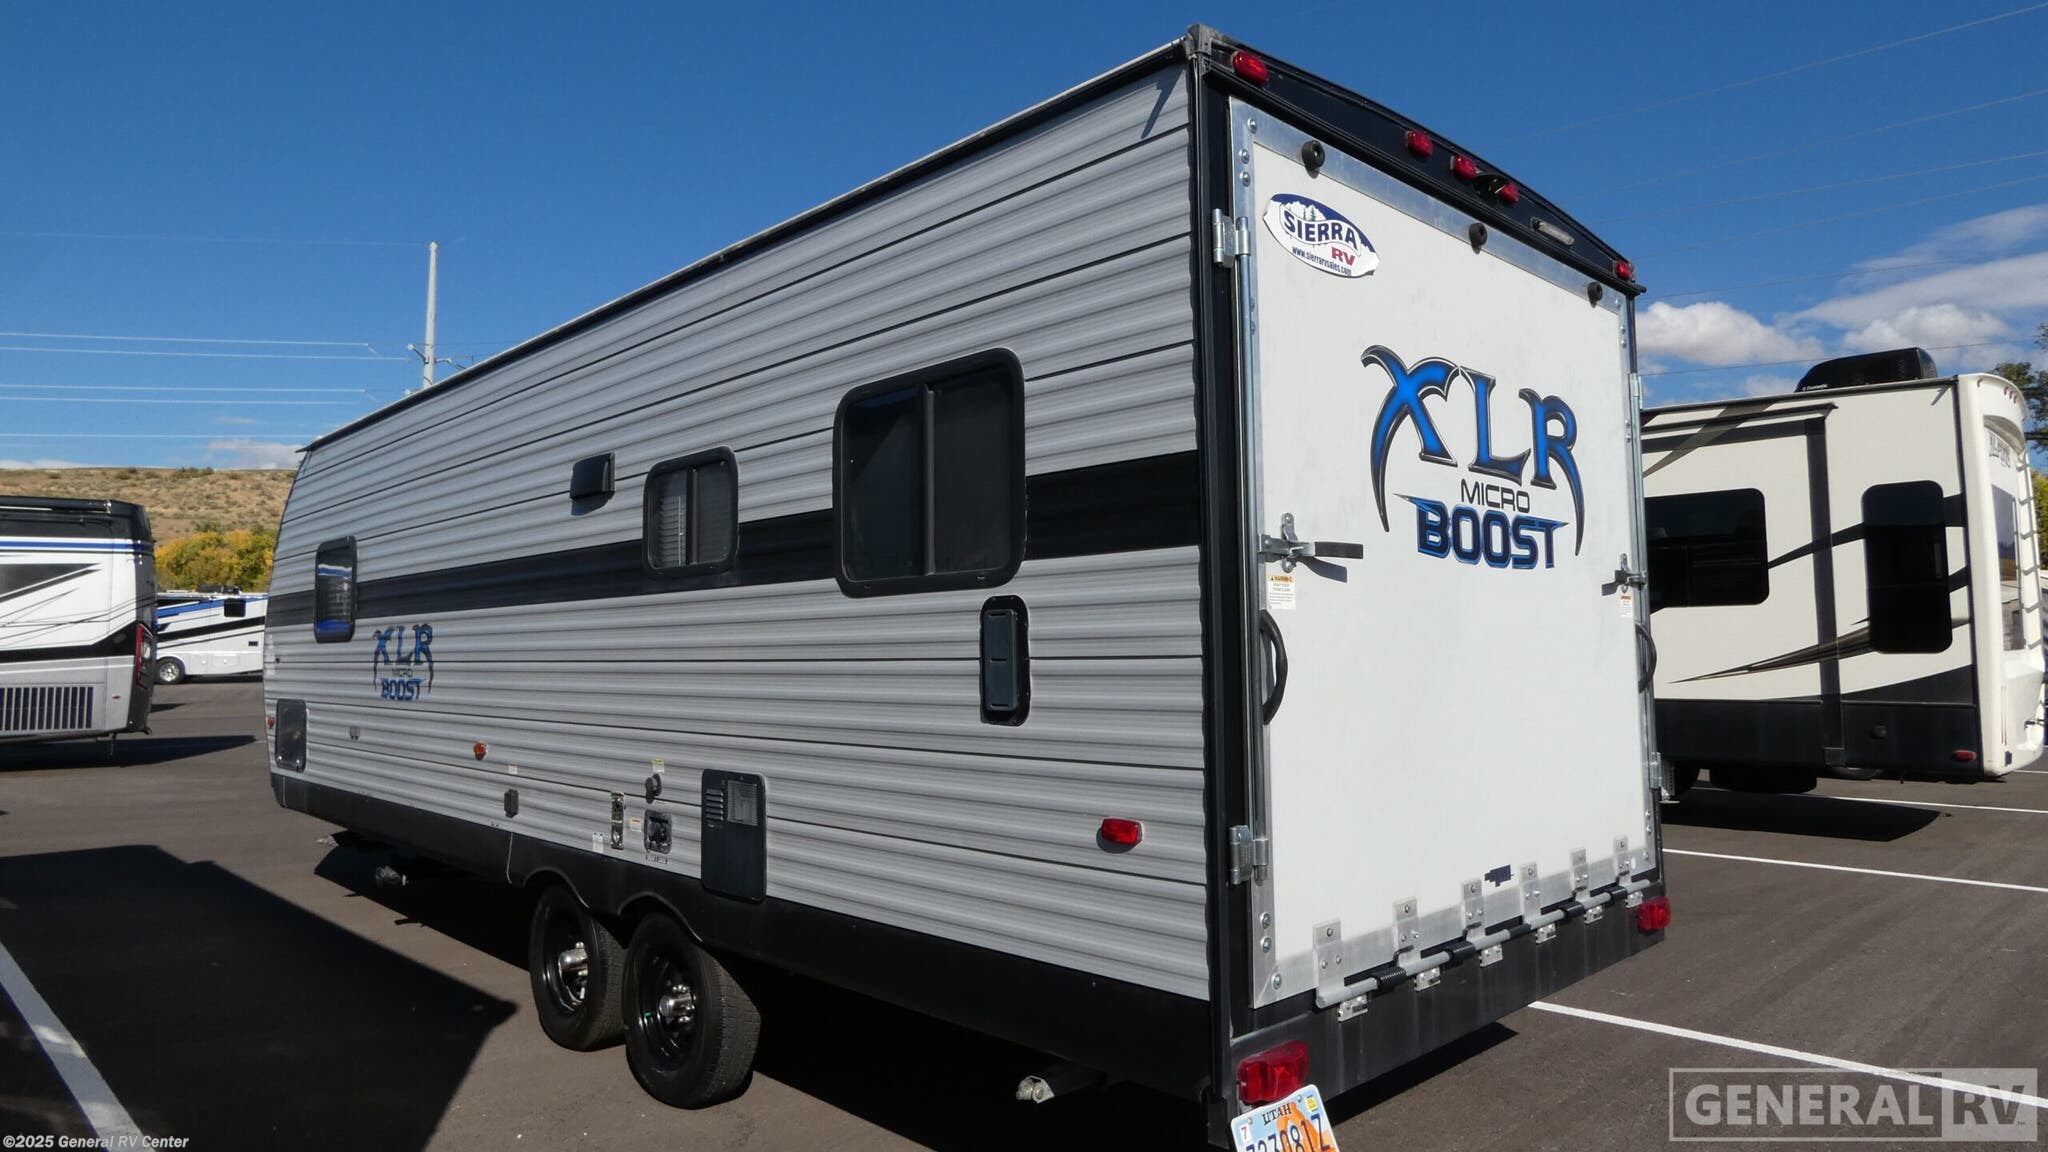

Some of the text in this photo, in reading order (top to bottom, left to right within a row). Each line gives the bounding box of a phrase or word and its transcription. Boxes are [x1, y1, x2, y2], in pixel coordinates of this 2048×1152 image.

[1284, 210, 1358, 251] SIERRA
[1331, 246, 1355, 266] RV
[1360, 344, 1585, 556] XLR
[1461, 478, 1531, 513] MICRO
[1392, 493, 1570, 569] BOOST
[372, 623, 434, 694] XLR
[380, 677, 425, 701] BOOST
[1262, 1103, 1292, 1126] UTAH
